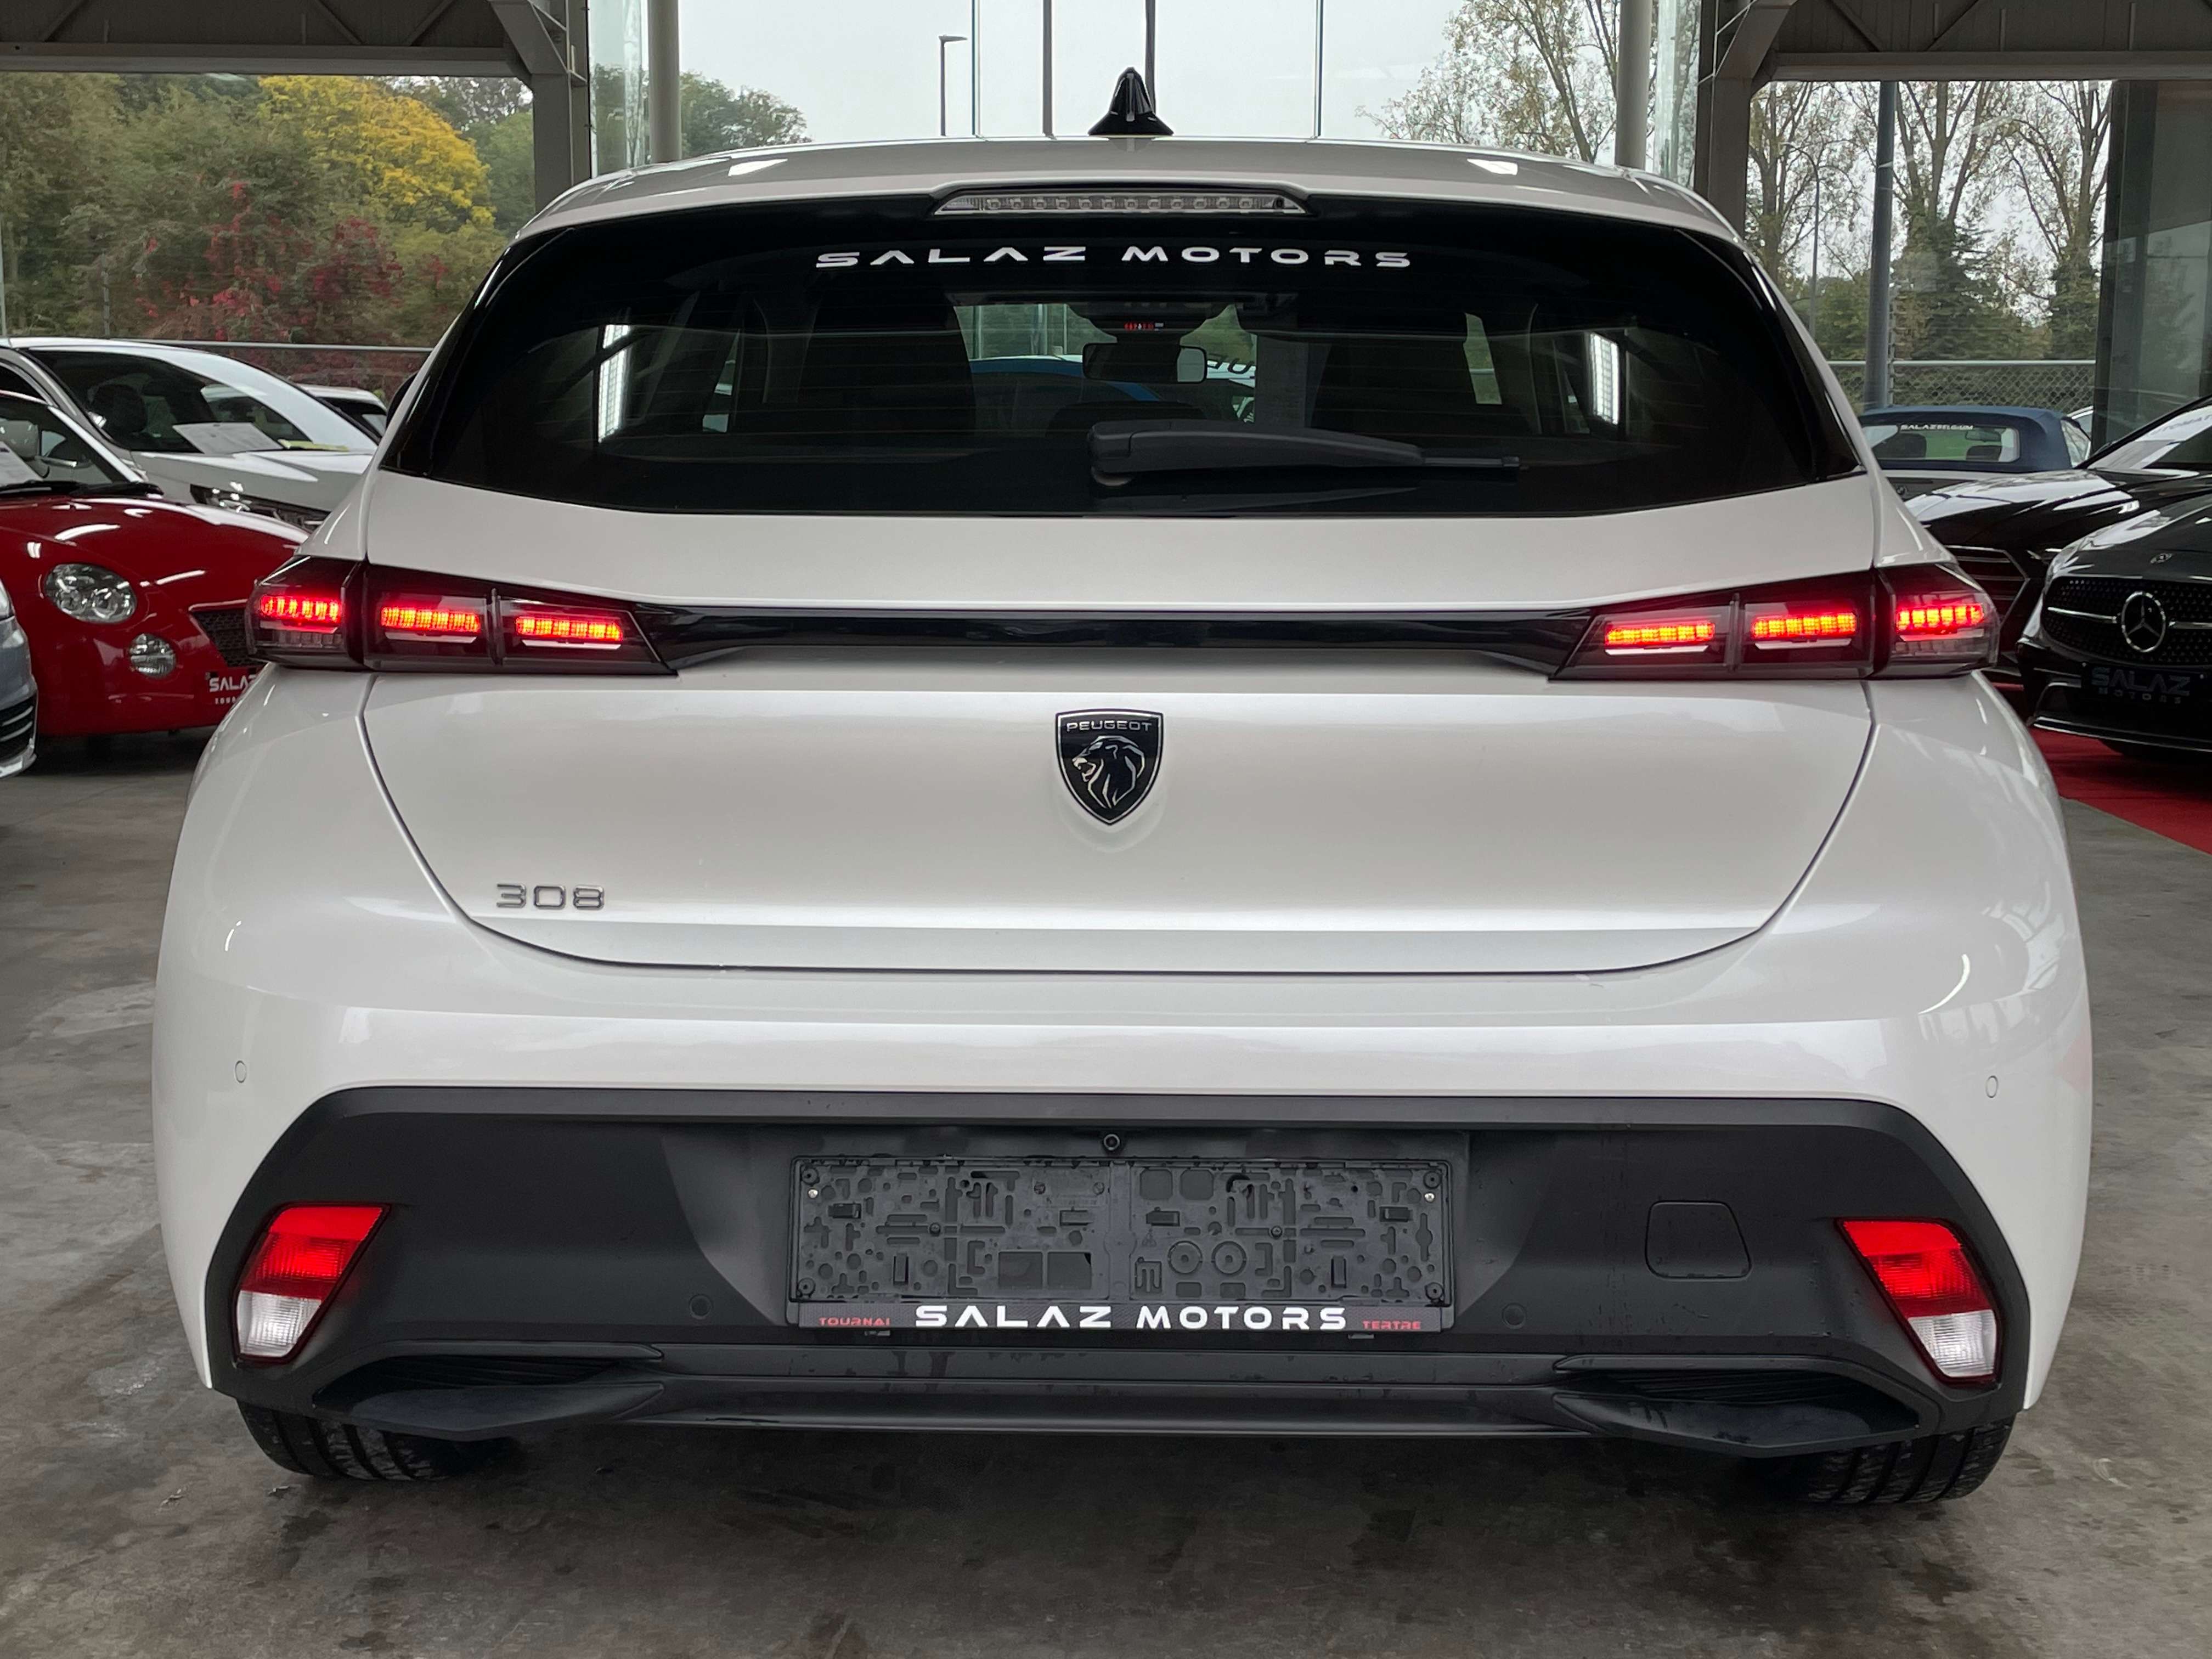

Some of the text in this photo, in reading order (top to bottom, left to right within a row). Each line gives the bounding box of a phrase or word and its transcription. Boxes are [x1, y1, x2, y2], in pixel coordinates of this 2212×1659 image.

[816, 246, 1410, 268] SALAZ MOTORS
[2091, 667, 2191, 696] SALAZ
[1066, 720, 1153, 732] PEUGEOT
[496, 884, 605, 910] 308
[819, 1317, 890, 1327] TOURNAI
[915, 1305, 1347, 1330] SALAZ MOTORS
[1362, 1320, 1421, 1330] TERTRE
